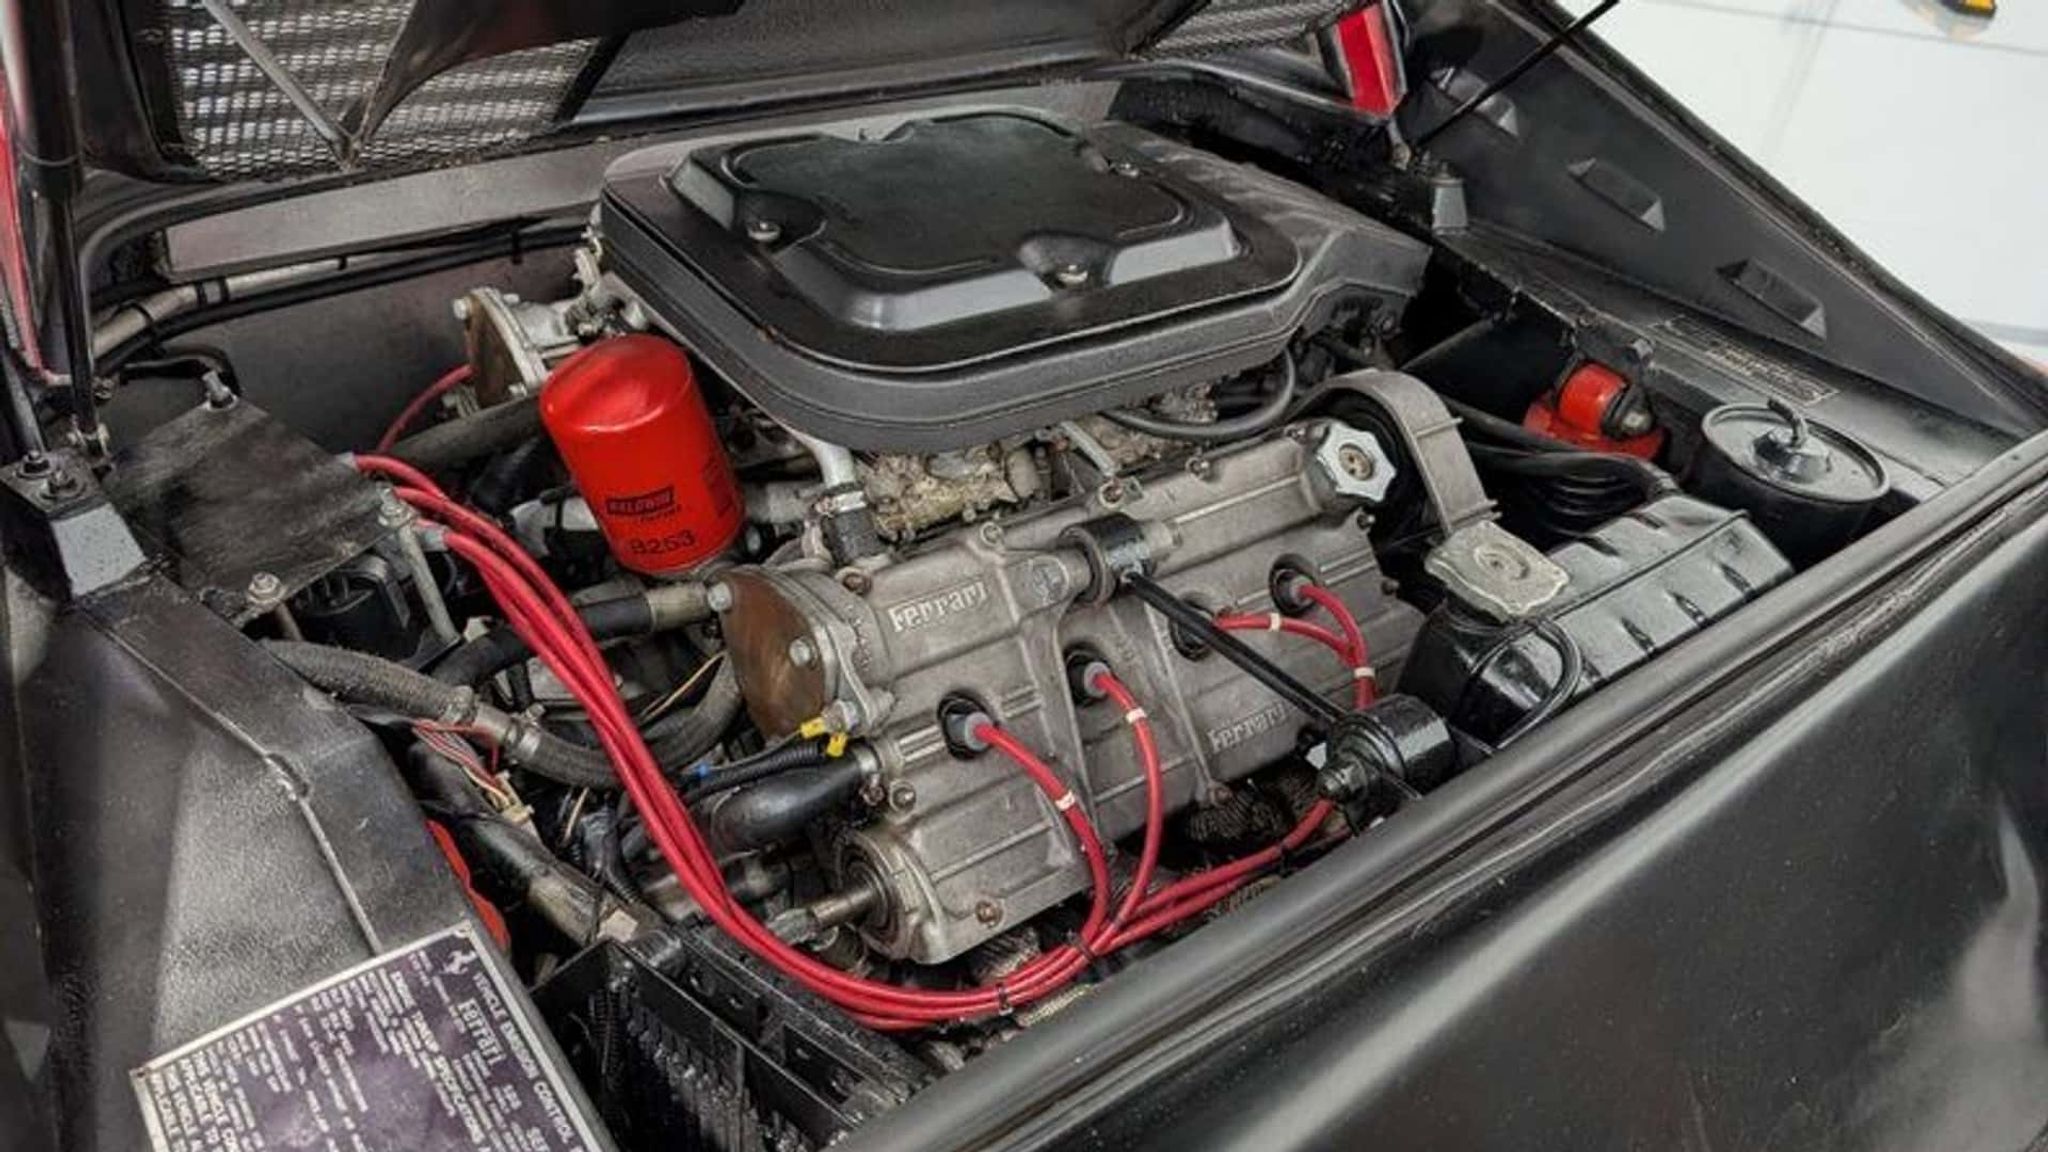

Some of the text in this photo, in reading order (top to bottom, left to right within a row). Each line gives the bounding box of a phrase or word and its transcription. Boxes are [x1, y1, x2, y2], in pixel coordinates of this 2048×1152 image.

[888, 581, 987, 632] Ferrari
[1207, 702, 1287, 753] Ferrari
[455, 997, 507, 1066] Ferrari
[471, 971, 506, 1020] VEHICLE
[498, 1020, 540, 1079] EMISSION
[531, 1079, 576, 1144] CONTROL
